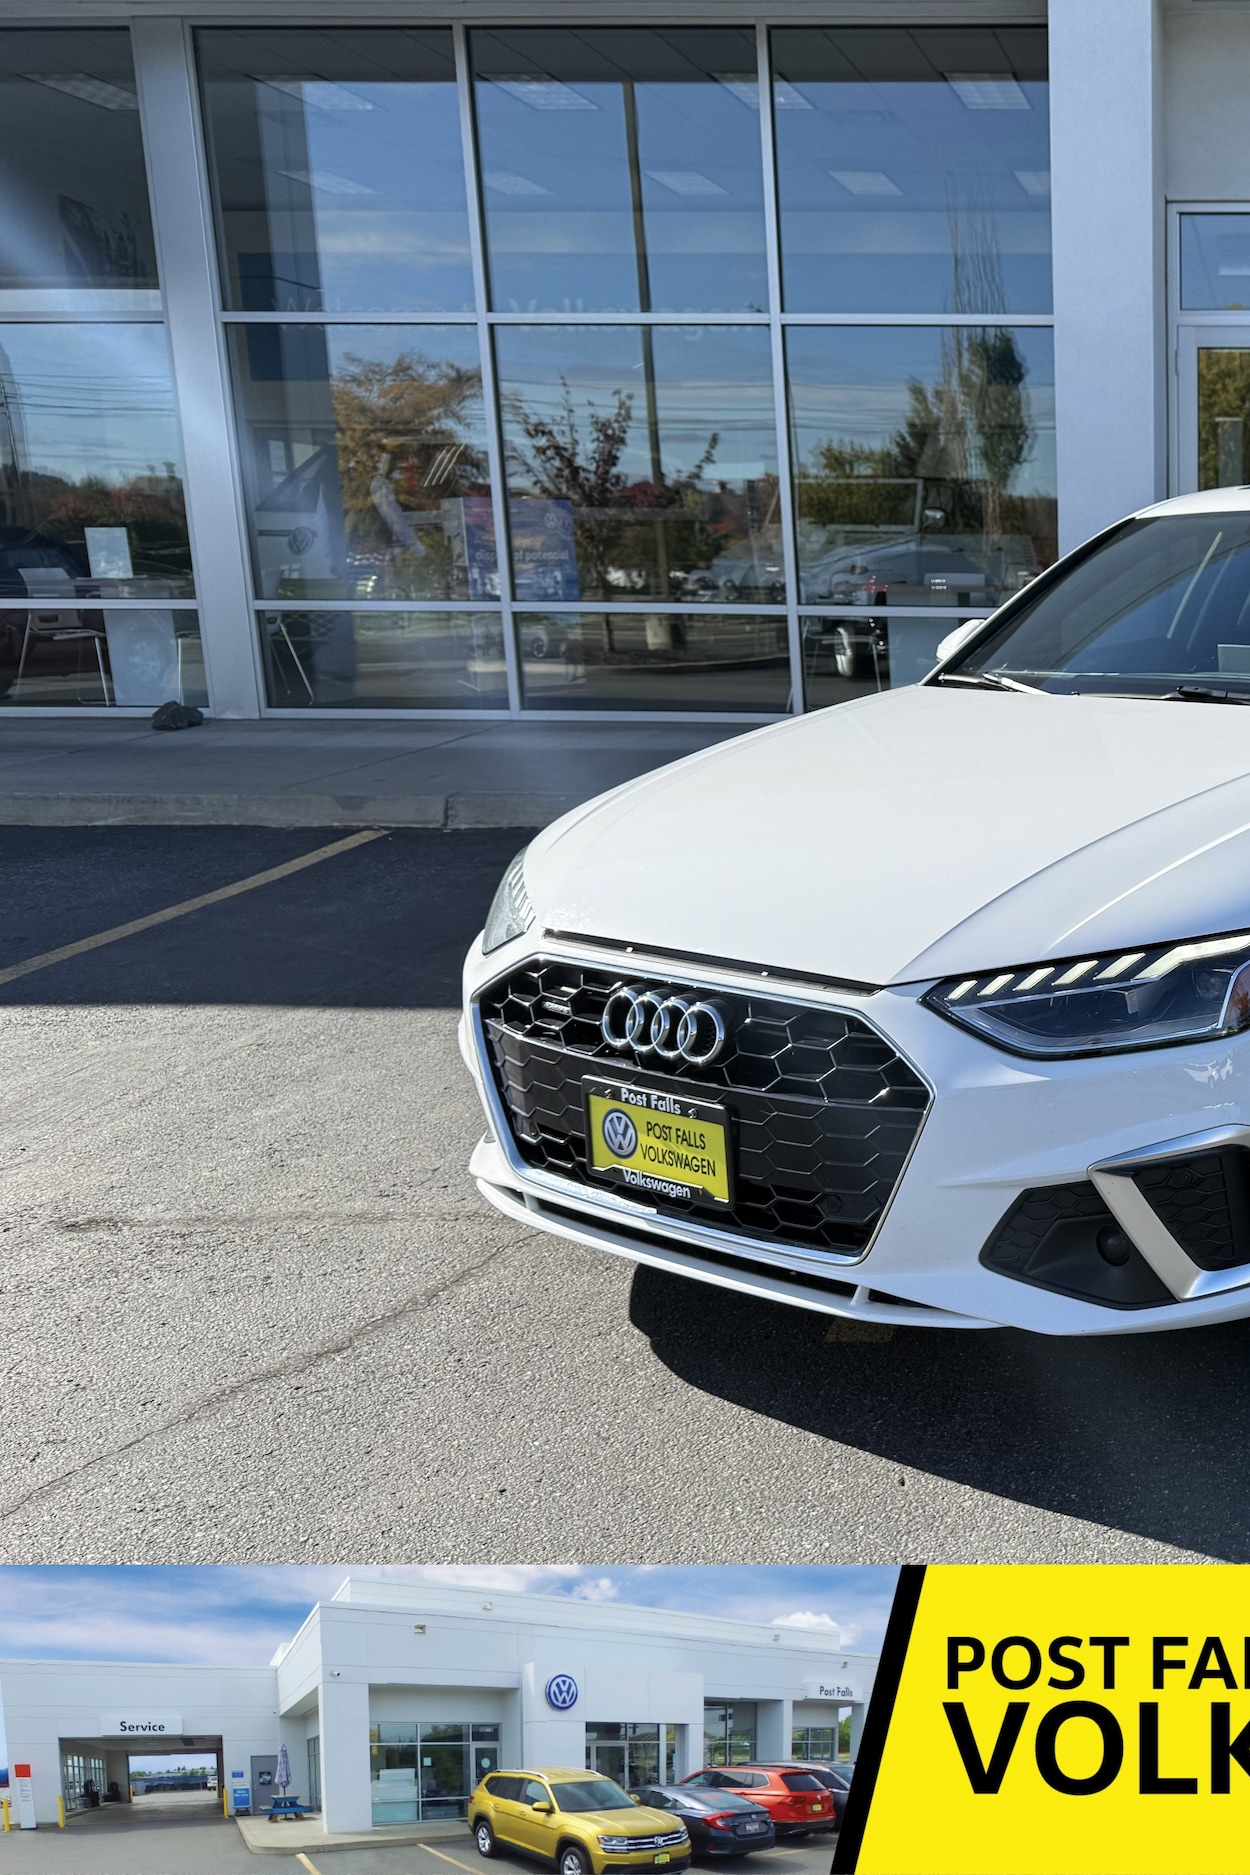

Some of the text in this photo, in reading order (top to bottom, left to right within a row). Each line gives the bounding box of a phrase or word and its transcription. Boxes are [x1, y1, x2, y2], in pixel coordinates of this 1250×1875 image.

[620, 1088, 682, 1115] Post Falls
[646, 1121, 706, 1150] POST FALLS
[640, 1143, 716, 1177] VOLKSWAGEN
[622, 1168, 691, 1199] Volkswagen
